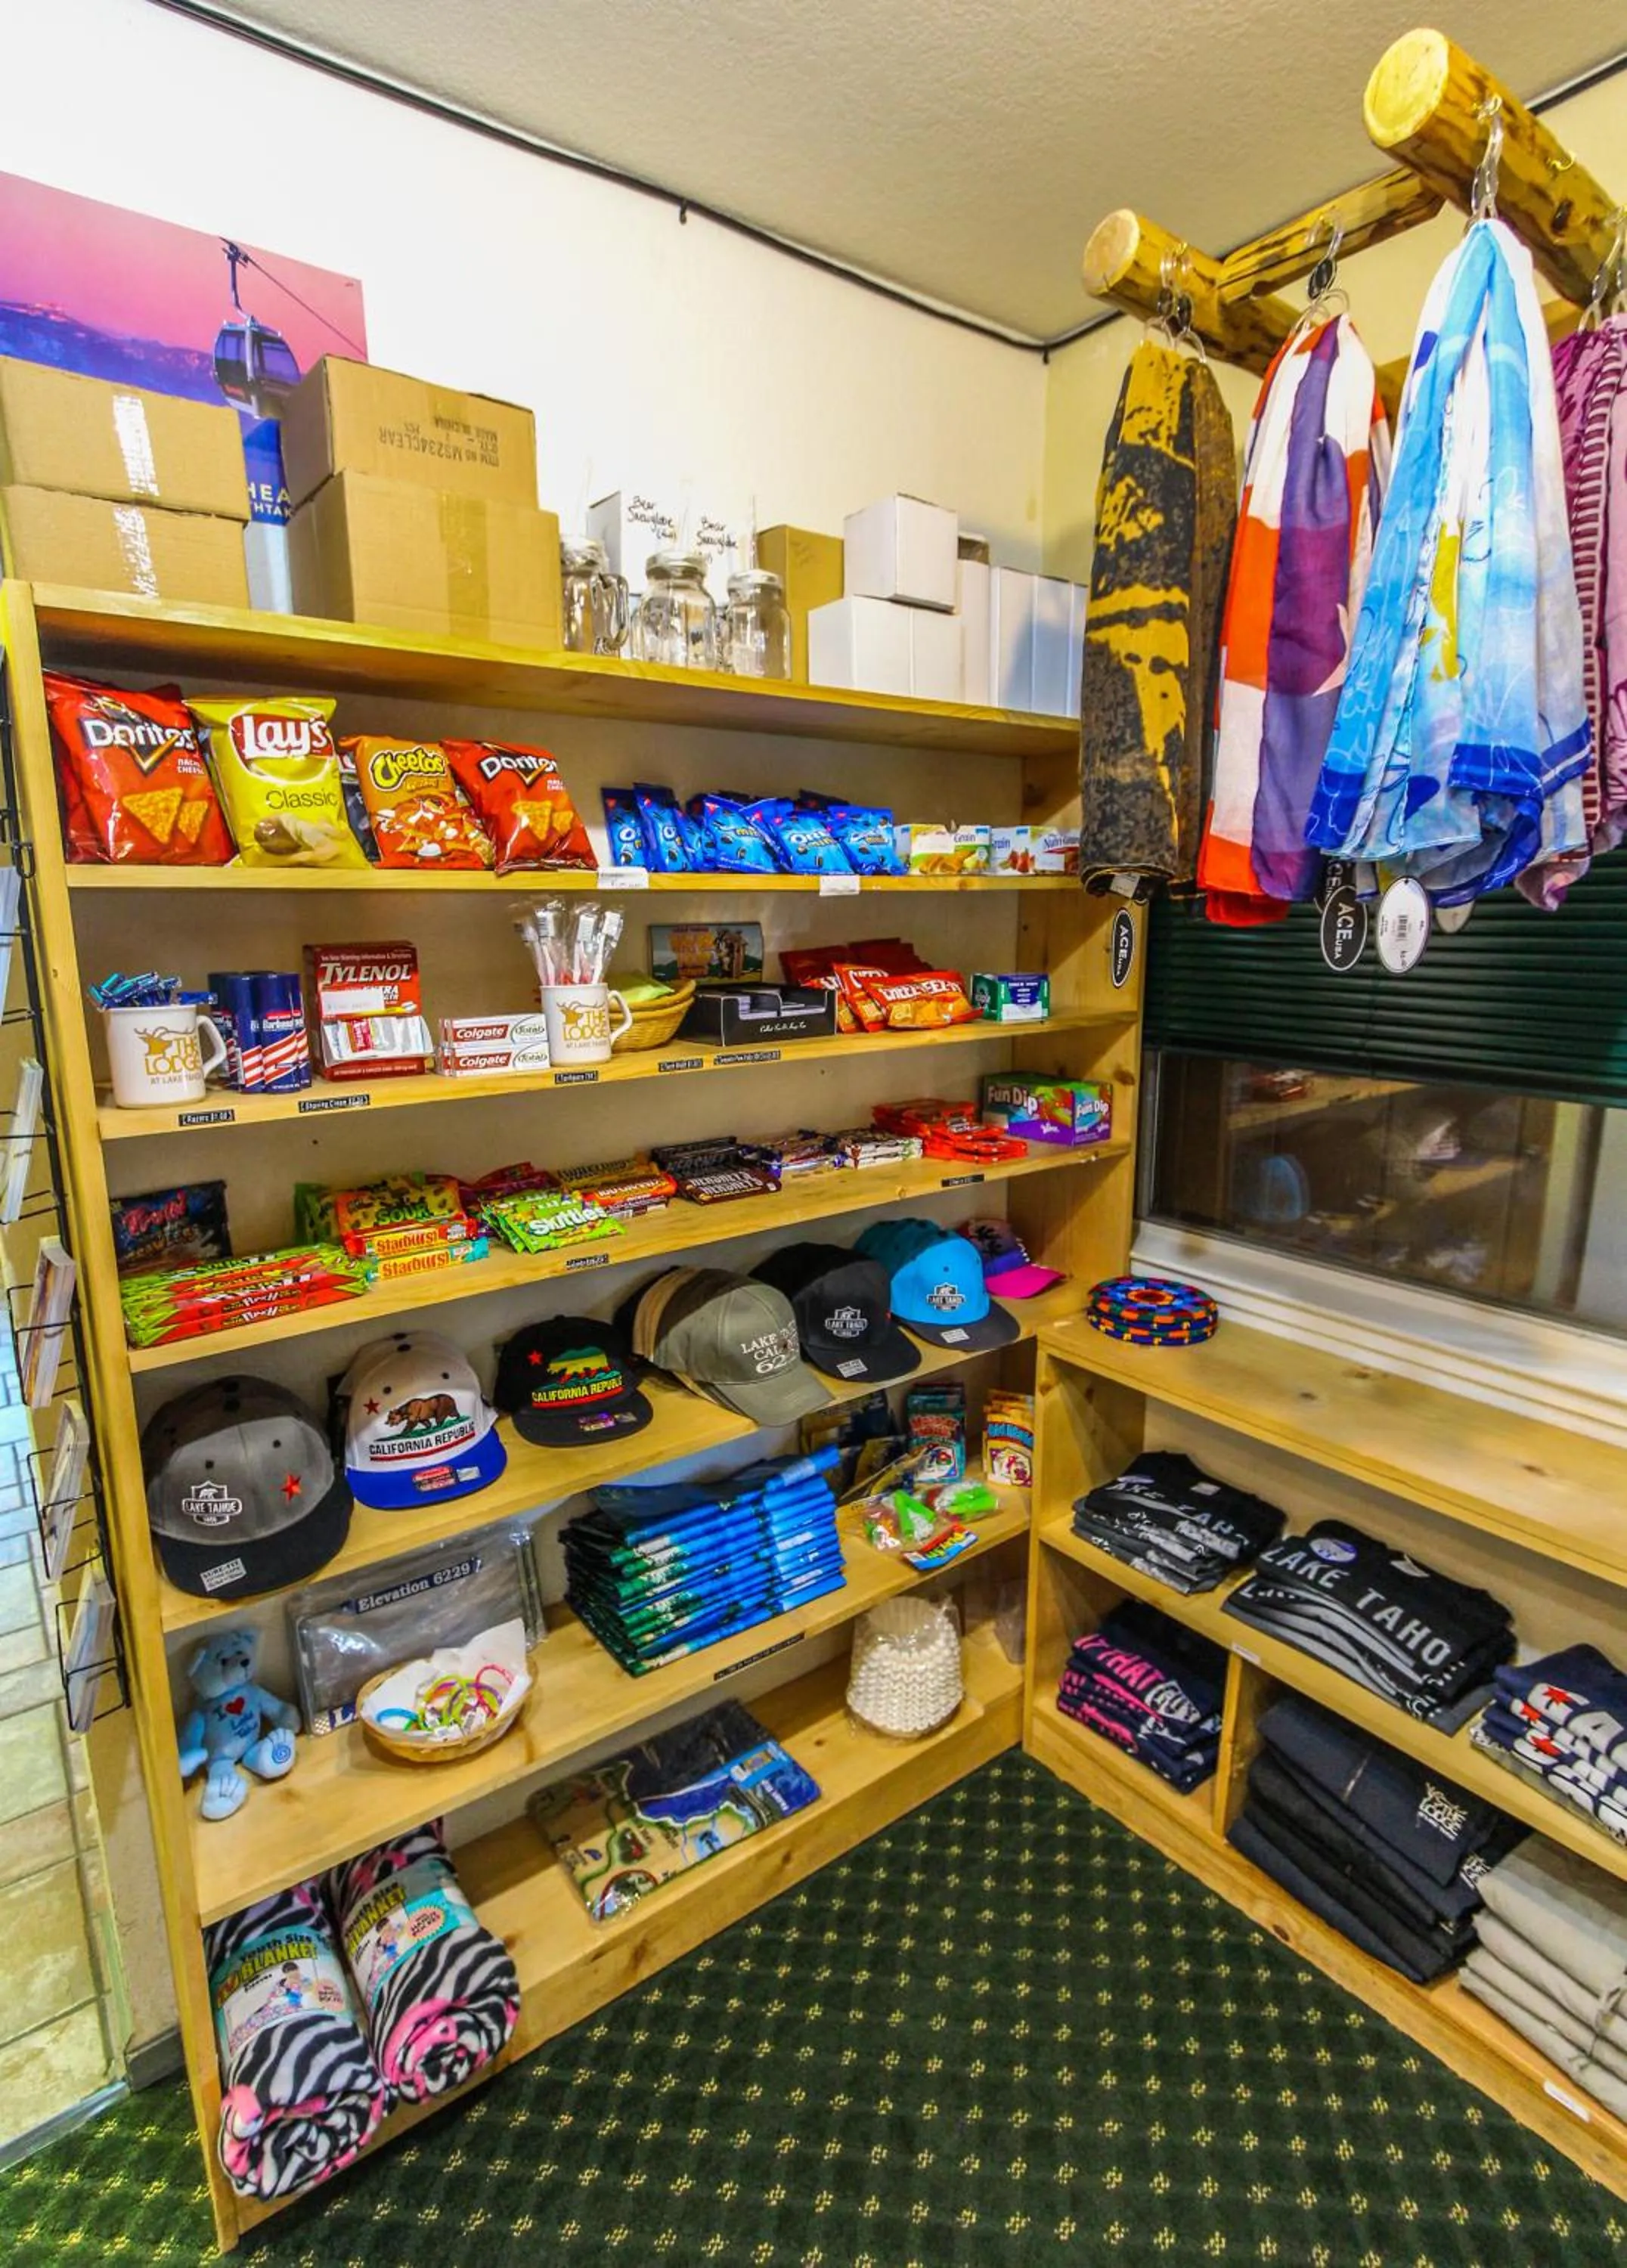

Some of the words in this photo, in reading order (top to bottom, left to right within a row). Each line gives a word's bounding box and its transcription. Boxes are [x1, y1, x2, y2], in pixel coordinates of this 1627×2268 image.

[84, 719, 196, 750] Doritos
[242, 715, 328, 761] Lay's
[371, 748, 445, 789] Cheetos
[265, 788, 338, 810] Classic
[1326, 859, 1343, 887] CE
[1336, 903, 1356, 940] ACE
[1119, 925, 1130, 959] ACE
[320, 962, 412, 984] TYLENOL
[456, 1027, 505, 1040] Colgate
[459, 1055, 507, 1068] Colgate
[987, 1085, 1012, 1103] Fun
[1012, 1086, 1038, 1117] Dip
[1076, 1102, 1093, 1117] Fun
[1093, 1099, 1110, 1115] Dip
[377, 1229, 438, 1253] Starburst
[381, 1251, 450, 1276] Starburst
[741, 1333, 778, 1354] LAKE
[532, 1384, 589, 1403] CALIFORNIA
[369, 1437, 432, 1455] CALIFORNIA
[185, 1501, 206, 1514] LAKE
[1260, 1546, 1351, 1588] LAKE
[357, 1579, 430, 1613] Elevation
